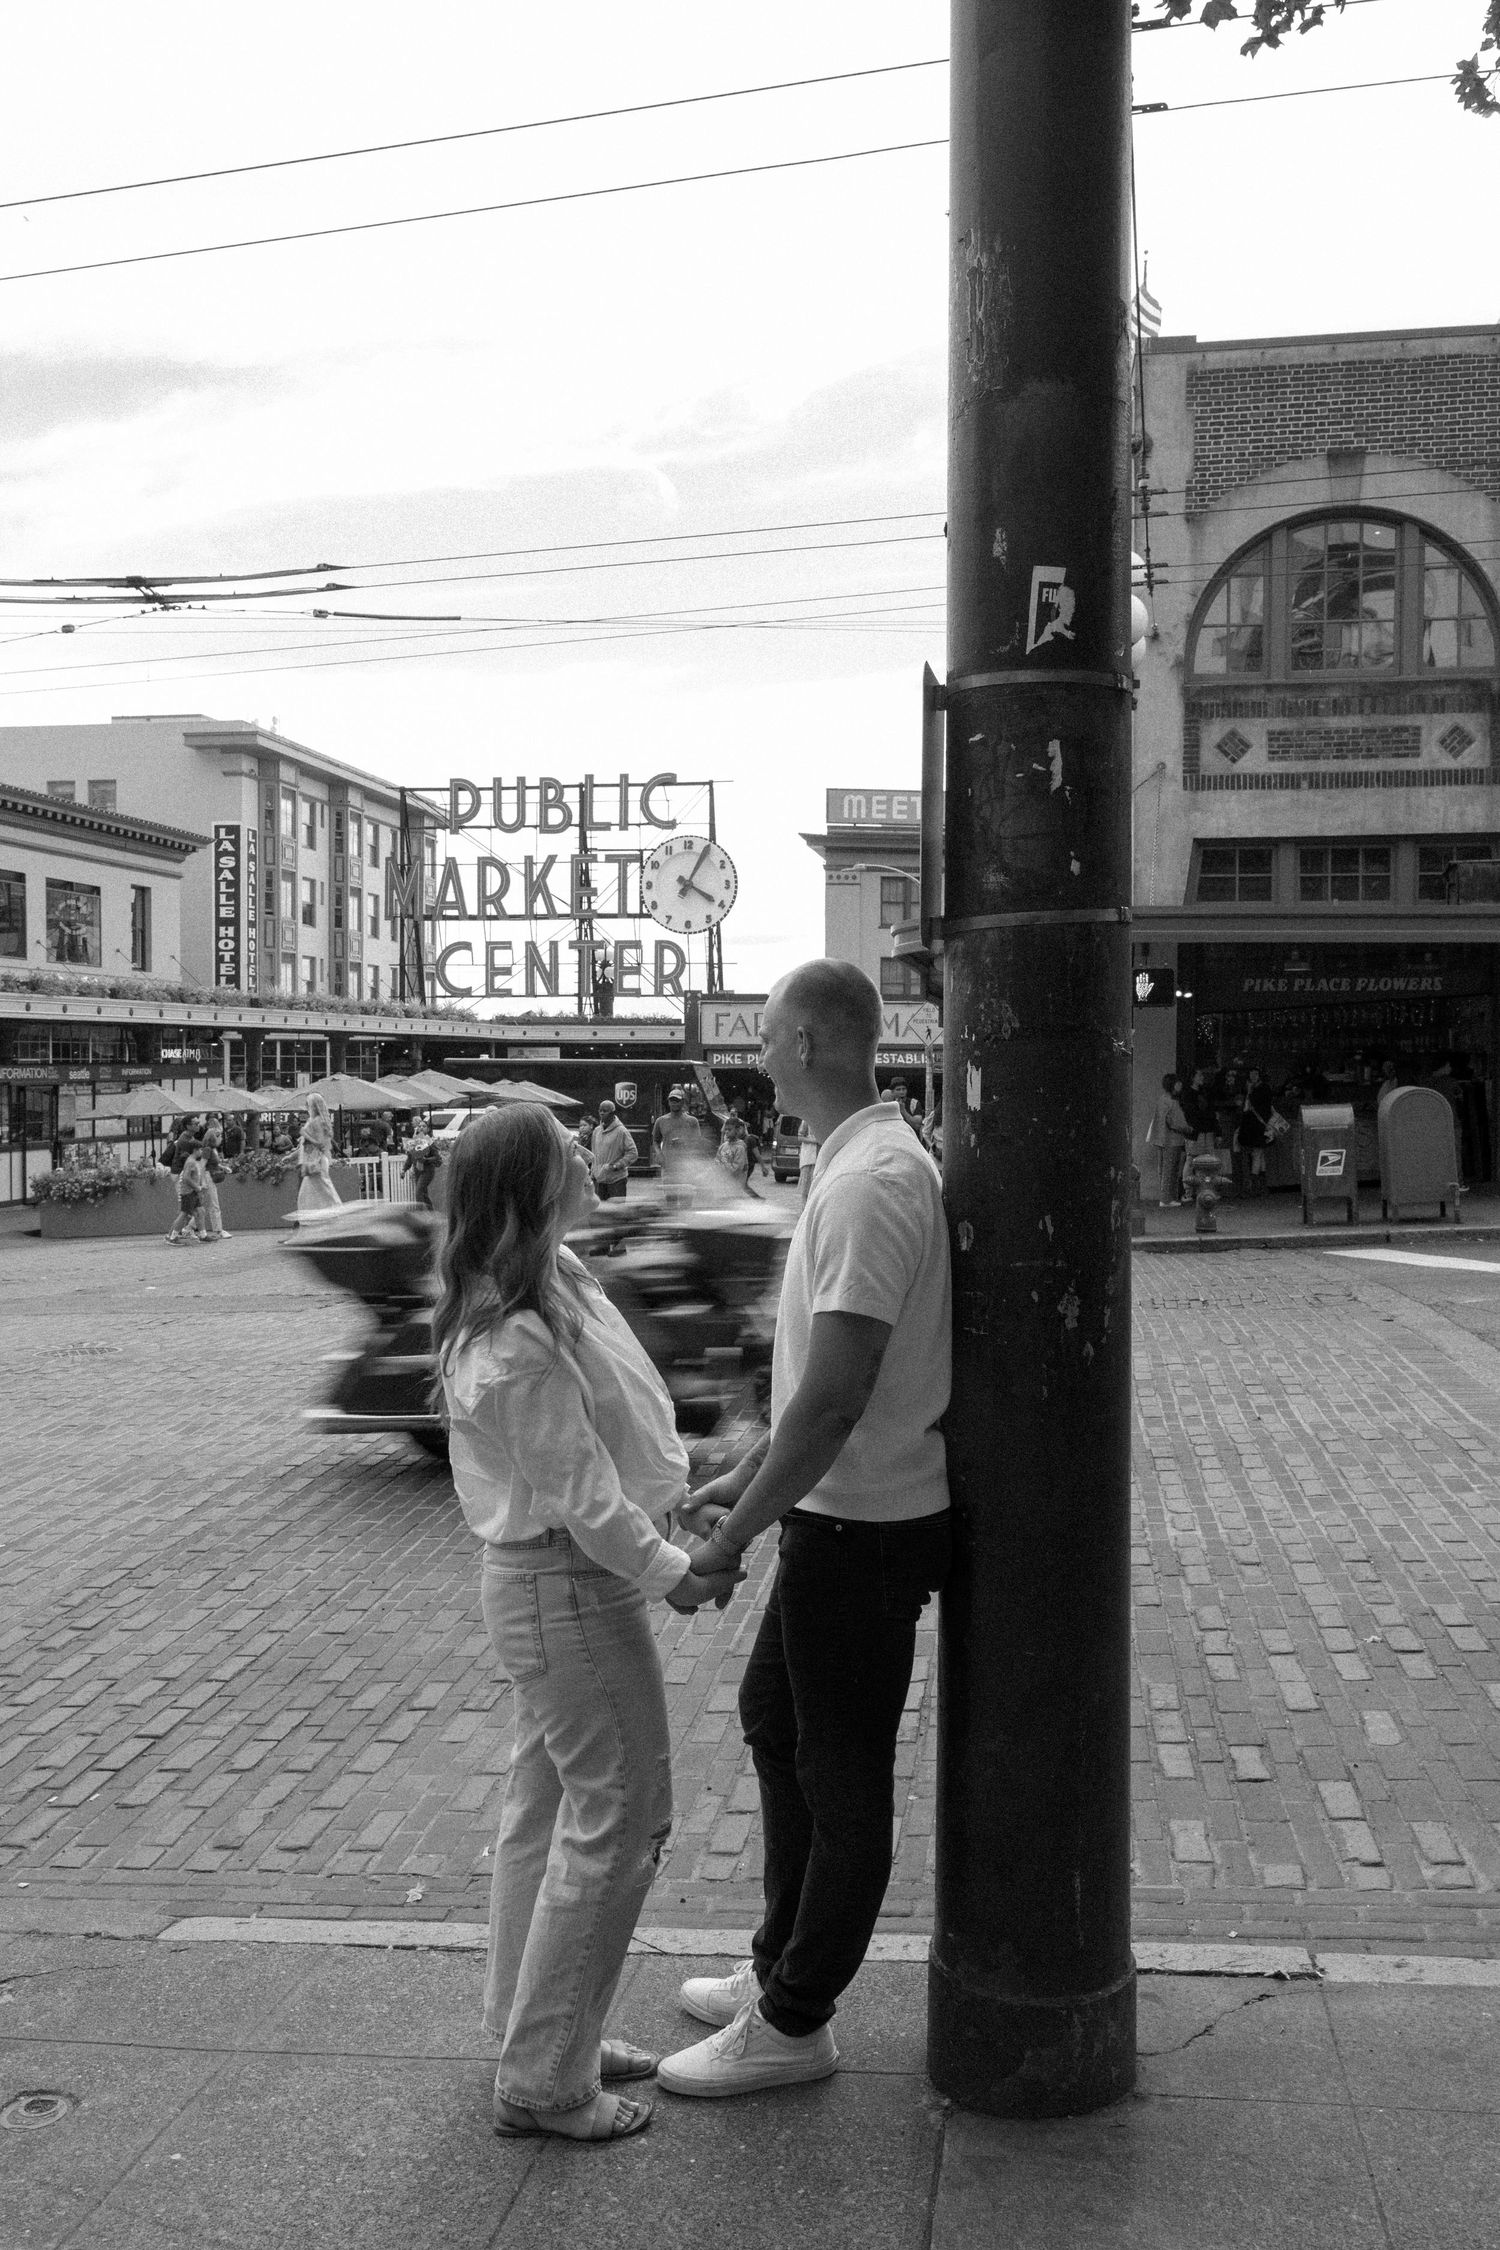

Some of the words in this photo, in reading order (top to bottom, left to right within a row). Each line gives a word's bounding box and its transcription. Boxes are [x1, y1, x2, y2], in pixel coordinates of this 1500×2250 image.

[450, 772, 677, 835] PUBLIC
[217, 827, 236, 851] LA
[247, 830, 257, 855] LA
[684, 840, 695, 850] 12
[665, 845, 673, 856] 11
[650, 860, 660, 870] 10
[719, 859, 726, 869] 2
[217, 856, 237, 918] SALLE
[247, 860, 257, 921] SALLE
[384, 853, 641, 921] MARKET
[645, 880, 653, 890] 9
[723, 879, 731, 890] 3
[650, 900, 658, 910] 8
[717, 899, 726, 910] 4
[665, 914, 673, 925] 7
[684, 920, 692, 930] 6
[705, 914, 713, 924] 5
[217, 926, 237, 989] HOTEL
[247, 927, 257, 988] HOTEL
[436, 940, 686, 998] CENTER
[1243, 978, 1289, 992] PIKE
[1293, 978, 1352, 992] PLACE
[1354, 976, 1445, 992] FLOWERS
[713, 1053, 742, 1065] PIKE
[0, 1067, 48, 1079] FORMATION
[617, 1089, 636, 1104] ups
